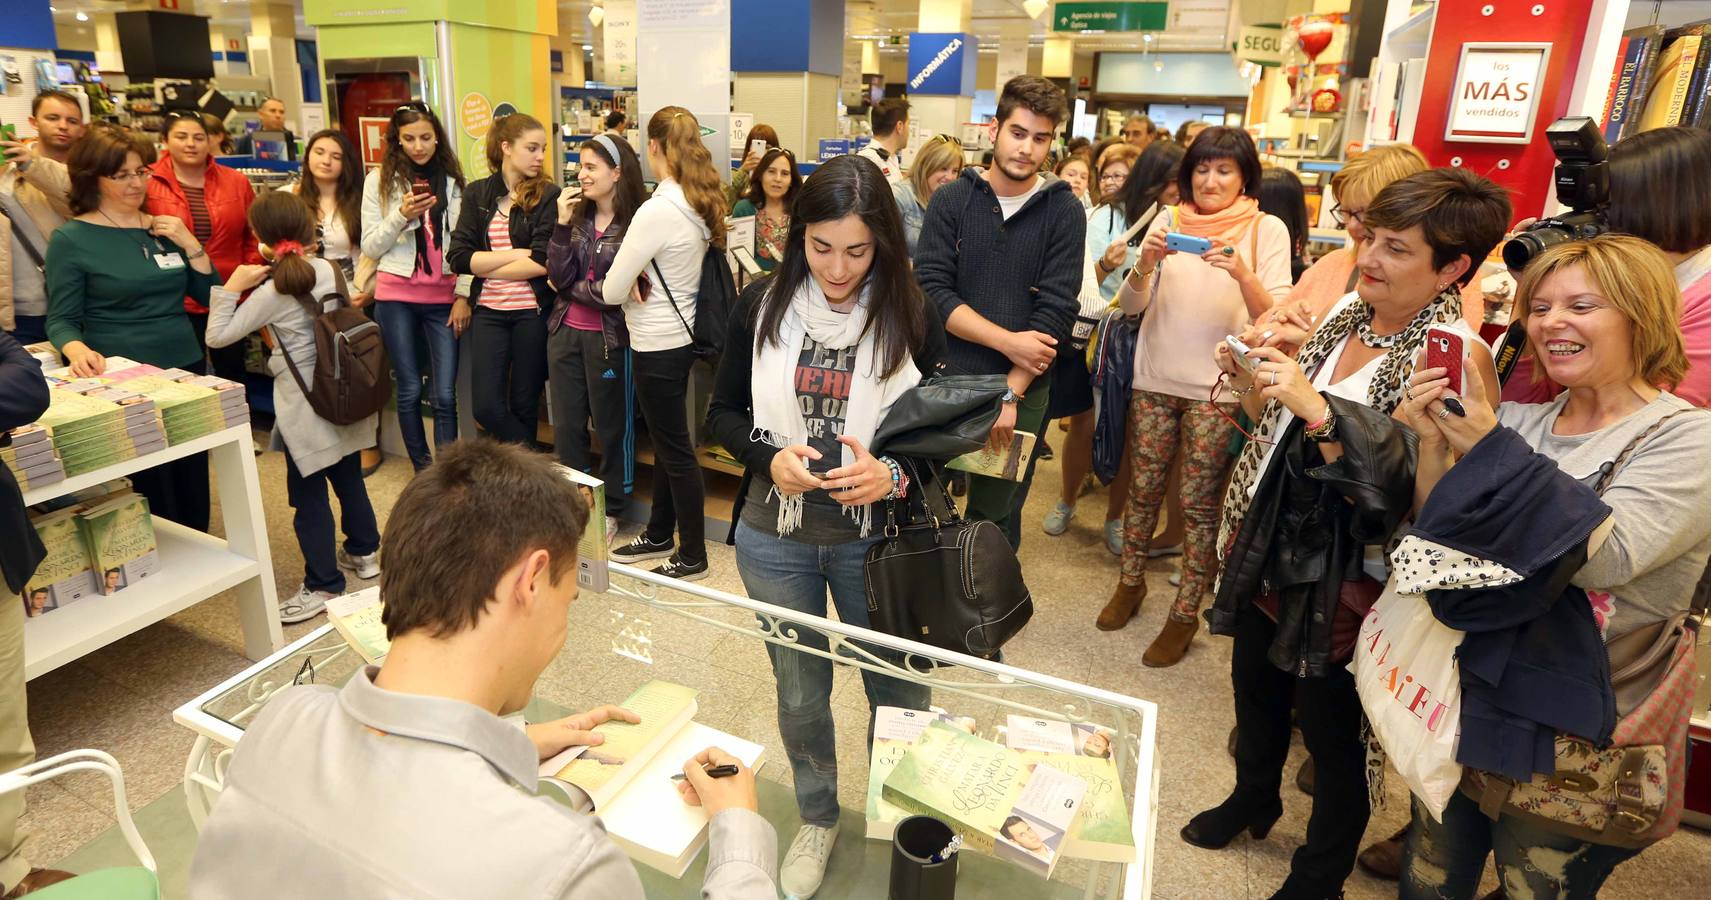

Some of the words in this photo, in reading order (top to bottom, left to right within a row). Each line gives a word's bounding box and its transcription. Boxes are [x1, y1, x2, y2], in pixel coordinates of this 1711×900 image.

[910, 38, 962, 89] INFORMÁTICA
[1493, 62, 1510, 71] los
[1623, 62, 1635, 74] EL
[1463, 76, 1529, 102] MÁS
[1611, 76, 1632, 122] BARROCO
[1465, 107, 1520, 118] vendidos
[1496, 345, 1516, 374] Nikon
